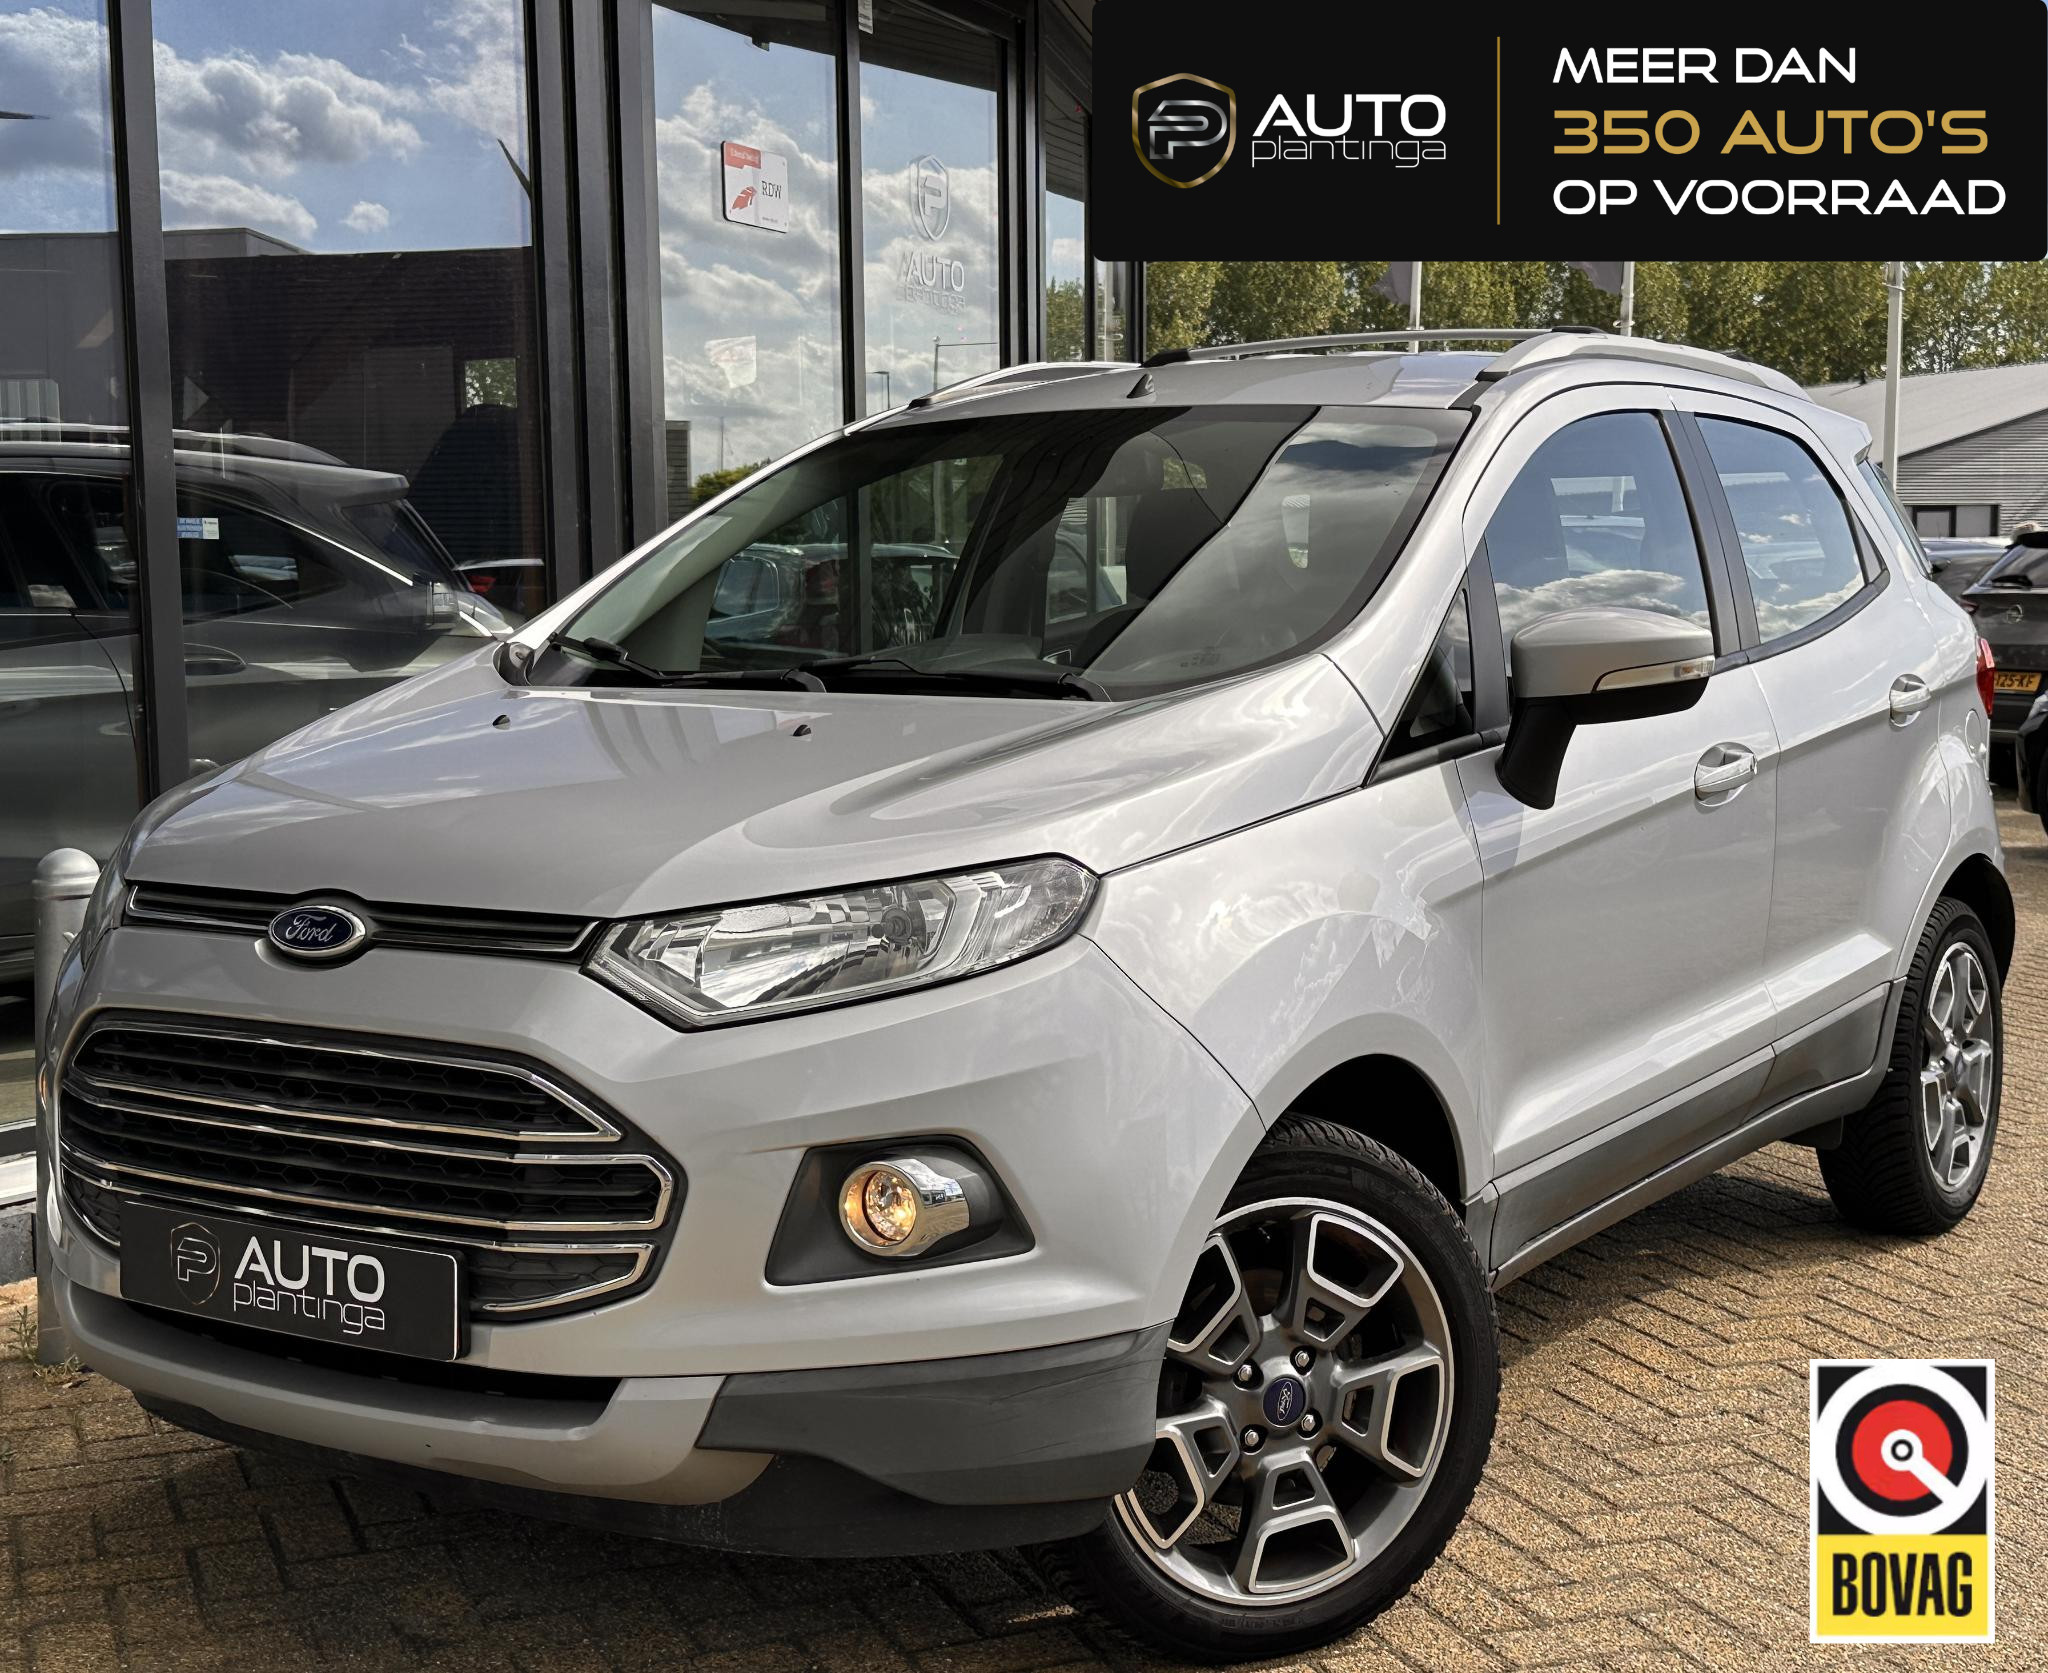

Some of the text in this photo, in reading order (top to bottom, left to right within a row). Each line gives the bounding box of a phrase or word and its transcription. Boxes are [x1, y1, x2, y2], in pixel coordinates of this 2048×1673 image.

[761, 180, 782, 199] RDW
[905, 250, 965, 293] AUTO
[285, 913, 337, 942] Ford
[233, 1235, 386, 1303] AUTO
[232, 1279, 386, 1336] plantinga
